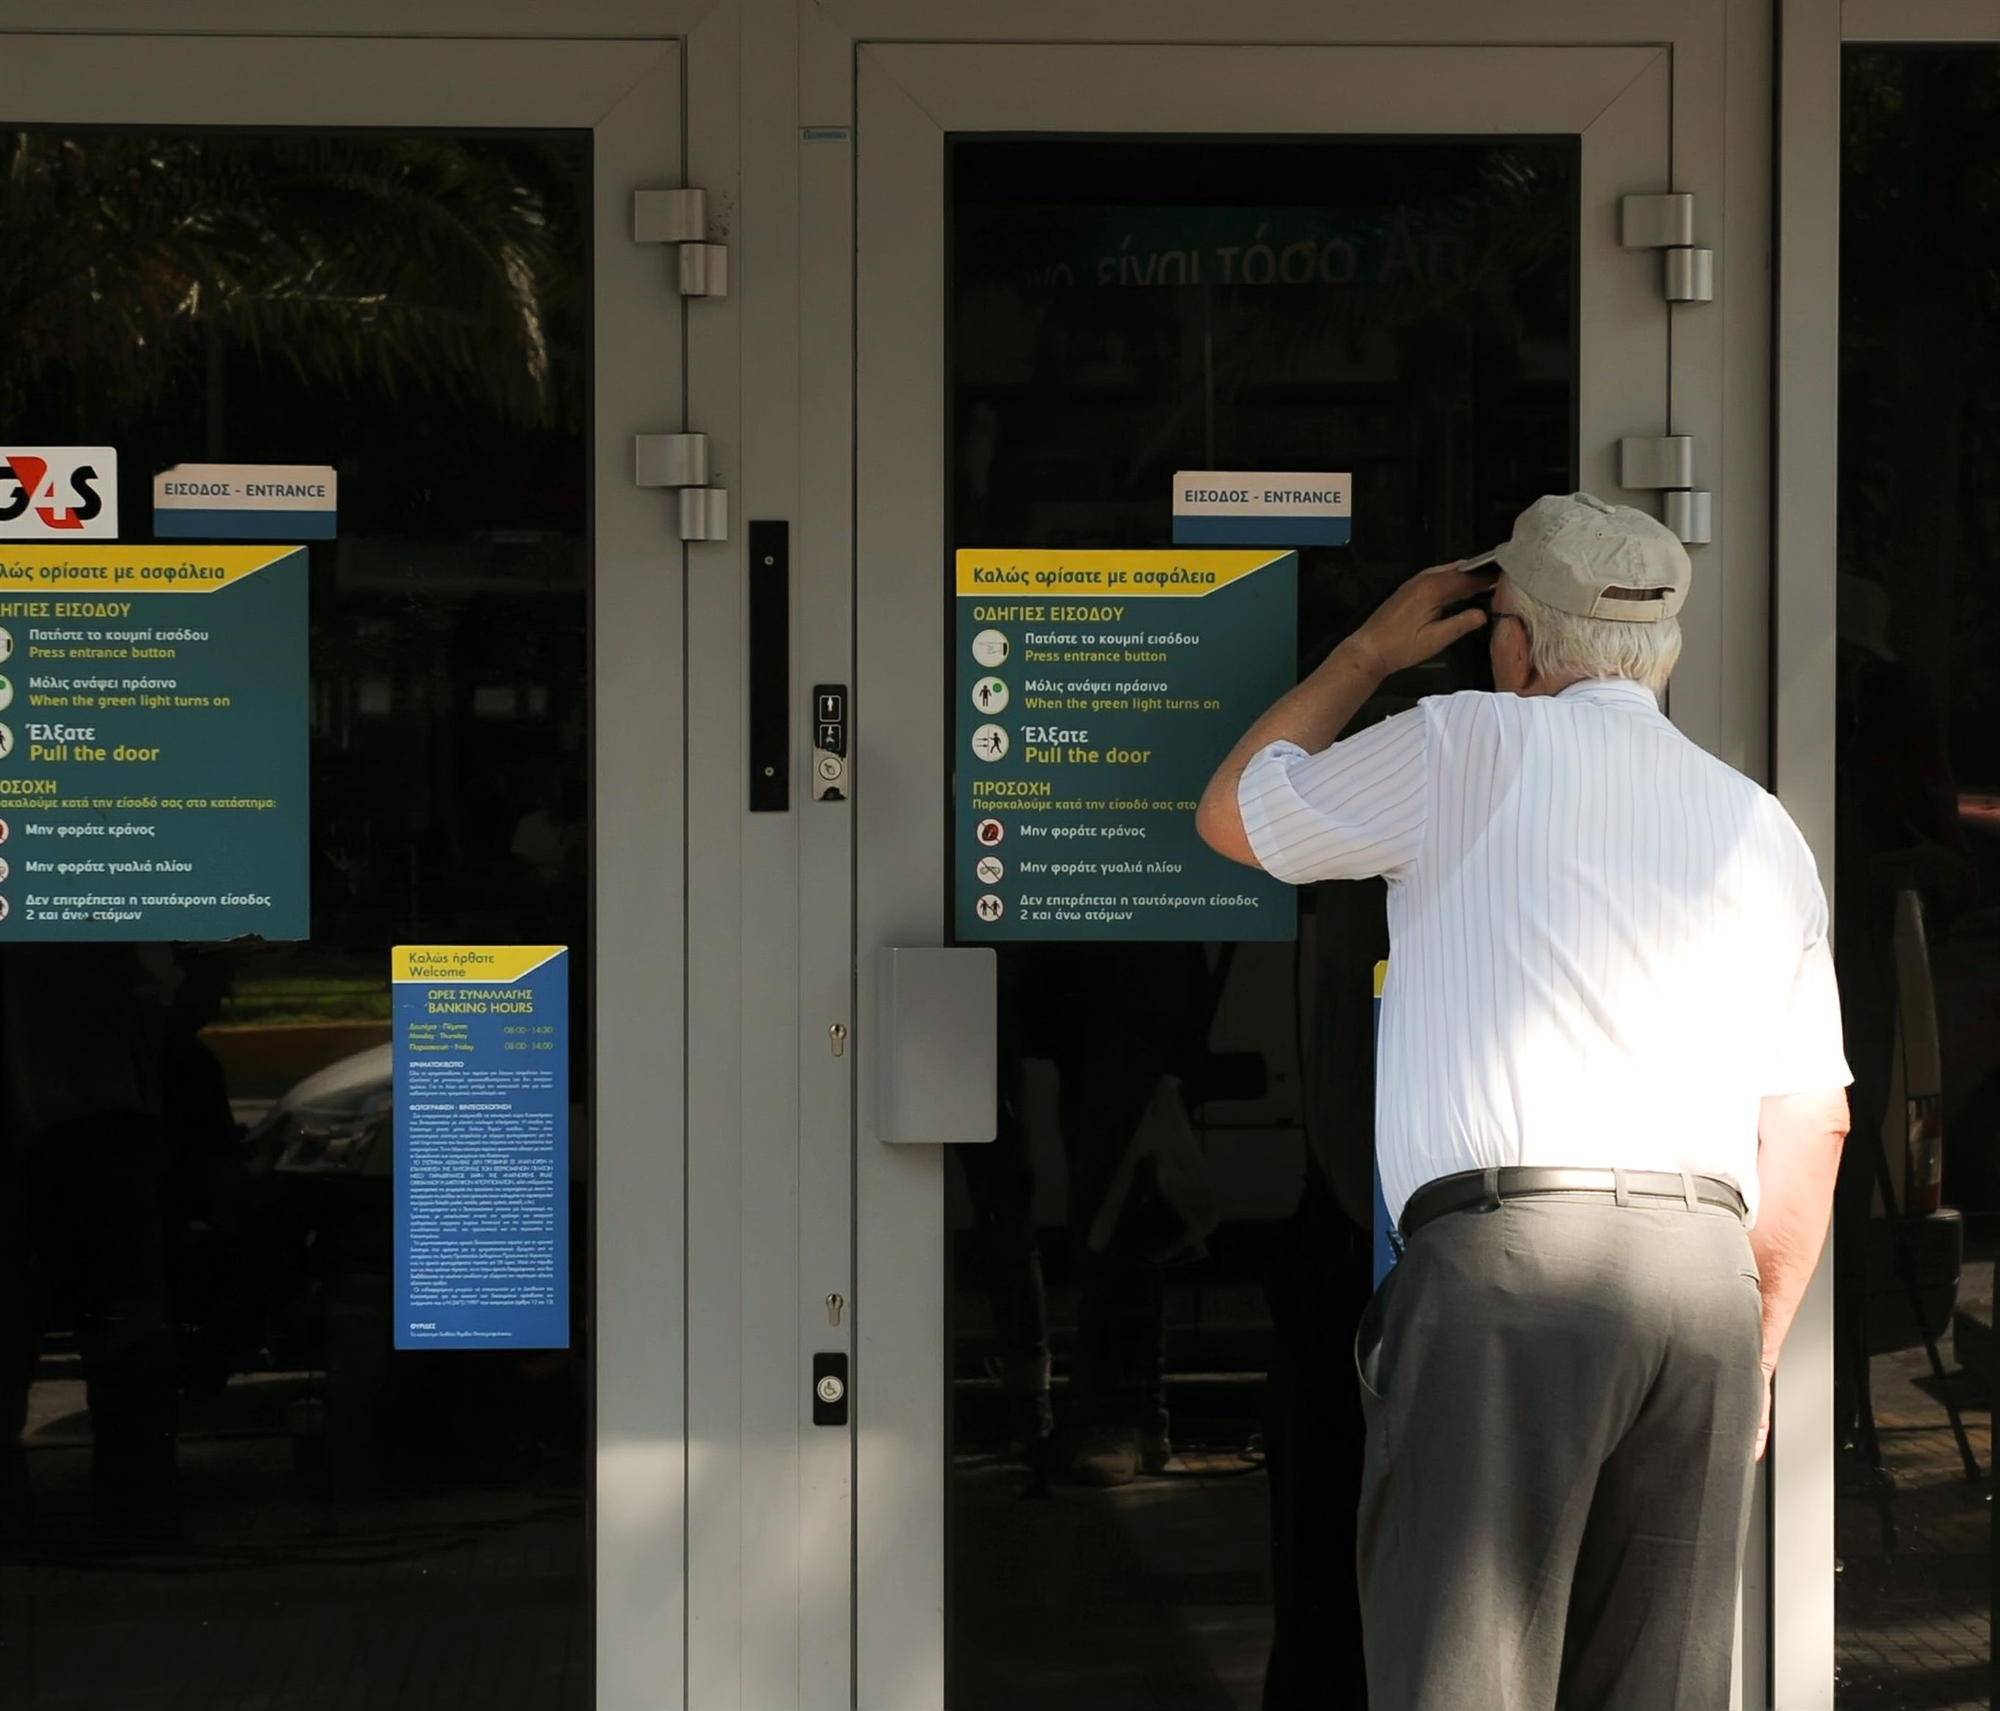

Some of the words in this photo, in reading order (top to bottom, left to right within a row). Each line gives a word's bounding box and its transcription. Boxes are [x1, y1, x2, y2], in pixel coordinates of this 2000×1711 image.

[1216, 225, 1357, 286] τόσο
[0, 457, 102, 529] G4S
[164, 483, 230, 496] ΕΙΣΟΔΟΣ
[246, 484, 326, 497] ENTRANCE
[1185, 490, 1249, 503] ΕΙΣΟΔΟΣ
[1264, 490, 1342, 504] ENTRANCE
[40, 562, 108, 582] ορίσατε
[115, 567, 135, 582] με
[140, 563, 225, 582] ασφάλεια
[974, 566, 1029, 586] Καλώς
[1035, 566, 1101, 587] ορίσατε
[1108, 571, 1127, 587] με
[1133, 565, 1215, 587] ασφάλεια
[0, 602, 50, 617] ΗΓΙΕΣ
[55, 602, 131, 617] ΕΙΣΟΔΟΥ
[973, 607, 1045, 621] ΟΔΗΓΙΕΣ
[1050, 607, 1124, 621] ΕΙΣΟΔΟΥ
[29, 629, 84, 641] Πατήστε
[87, 632, 102, 641] το
[106, 629, 152, 644] κουμπί
[155, 628, 209, 641] εισόδου
[1025, 632, 1078, 644] Πατήστε
[1081, 635, 1096, 644] το
[1099, 632, 1144, 647] κουμπί
[1147, 632, 1200, 645] εισόδου
[29, 647, 65, 658] Press
[69, 648, 128, 658] entrance
[132, 647, 175, 658] button
[1025, 650, 1060, 662] Press
[1064, 651, 1120, 662] entrance
[1124, 650, 1167, 662] button
[29, 676, 69, 691] Μόλις
[73, 676, 118, 691] ανάψει
[122, 676, 177, 692] πράσινο
[1025, 680, 1063, 693] Μόλις
[1067, 679, 1112, 694] ανάψει
[1115, 679, 1168, 694] πράσινο
[29, 695, 68, 706] When
[72, 695, 94, 706] the
[99, 697, 136, 709] green
[140, 695, 171, 709] light
[174, 696, 209, 706] turns
[213, 698, 230, 706] on
[1025, 698, 1063, 710] When
[1066, 698, 1088, 710] the
[1091, 700, 1129, 712] green
[1132, 698, 1162, 712] light
[1165, 700, 1200, 710] turns
[1203, 701, 1220, 710] on
[25, 724, 96, 742] Έλξατε
[1020, 726, 1088, 745] Έλξατε
[30, 745, 68, 761] Pull
[74, 746, 107, 761] the
[113, 745, 160, 762] door
[1025, 747, 1062, 763] Pull
[1068, 748, 1099, 763] the
[1106, 747, 1151, 763] door
[0, 780, 57, 794] ΟΣΟΧΗ
[973, 782, 1051, 796] ΠΡΟΣΟΧΗ
[61, 797, 89, 808] κατά
[93, 801, 113, 809] την
[161, 800, 183, 810] σας
[186, 800, 207, 808] στο
[972, 799, 1052, 811] Παρακαλούμε
[1055, 799, 1083, 810] κατά
[1086, 801, 1106, 810] την
[1152, 801, 1173, 811] σας
[1176, 801, 1197, 810] στο
[26, 824, 54, 835] Μην
[57, 823, 105, 838] φοράτε
[108, 823, 156, 838] κράνος
[1020, 825, 1048, 836] Μην
[1051, 824, 1097, 839] φοράτε
[1101, 824, 1146, 839] κράνος
[26, 861, 54, 872] Μην
[57, 860, 105, 875] φοράτε
[108, 859, 152, 875] γυαλιά
[155, 859, 192, 873] ηλίου
[1020, 862, 1048, 873] Μην
[1051, 861, 1097, 876] φοράτε
[1101, 861, 1143, 876] γυαλιά
[1147, 861, 1182, 875] ηλίου
[26, 894, 50, 905] Δεν
[53, 892, 126, 908] επιτρέπεται
[141, 893, 217, 908] ταυτόχρονη
[220, 893, 271, 907] είσοδος
[1020, 895, 1043, 906] Δεν
[1046, 894, 1117, 909] επιτρέπεται
[1132, 894, 1206, 909] ταυτόχρονη
[1210, 894, 1259, 908] είσοδος
[25, 909, 35, 920] 2
[39, 911, 58, 920] και
[1020, 910, 1029, 921] 2
[1032, 911, 1052, 921] και
[1055, 908, 1081, 921] άνω
[1085, 908, 1133, 922] ατόμων
[409, 952, 448, 963] Καλώς
[453, 952, 495, 966] ήρθατε
[409, 966, 466, 977] Welcome
[428, 990, 456, 1000] ΩΡΕΣ
[460, 990, 533, 1000] ΣΥΝΑΛΛΑΓΗΣ
[428, 1002, 487, 1014] BANKING
[490, 1002, 533, 1014] HOURS
